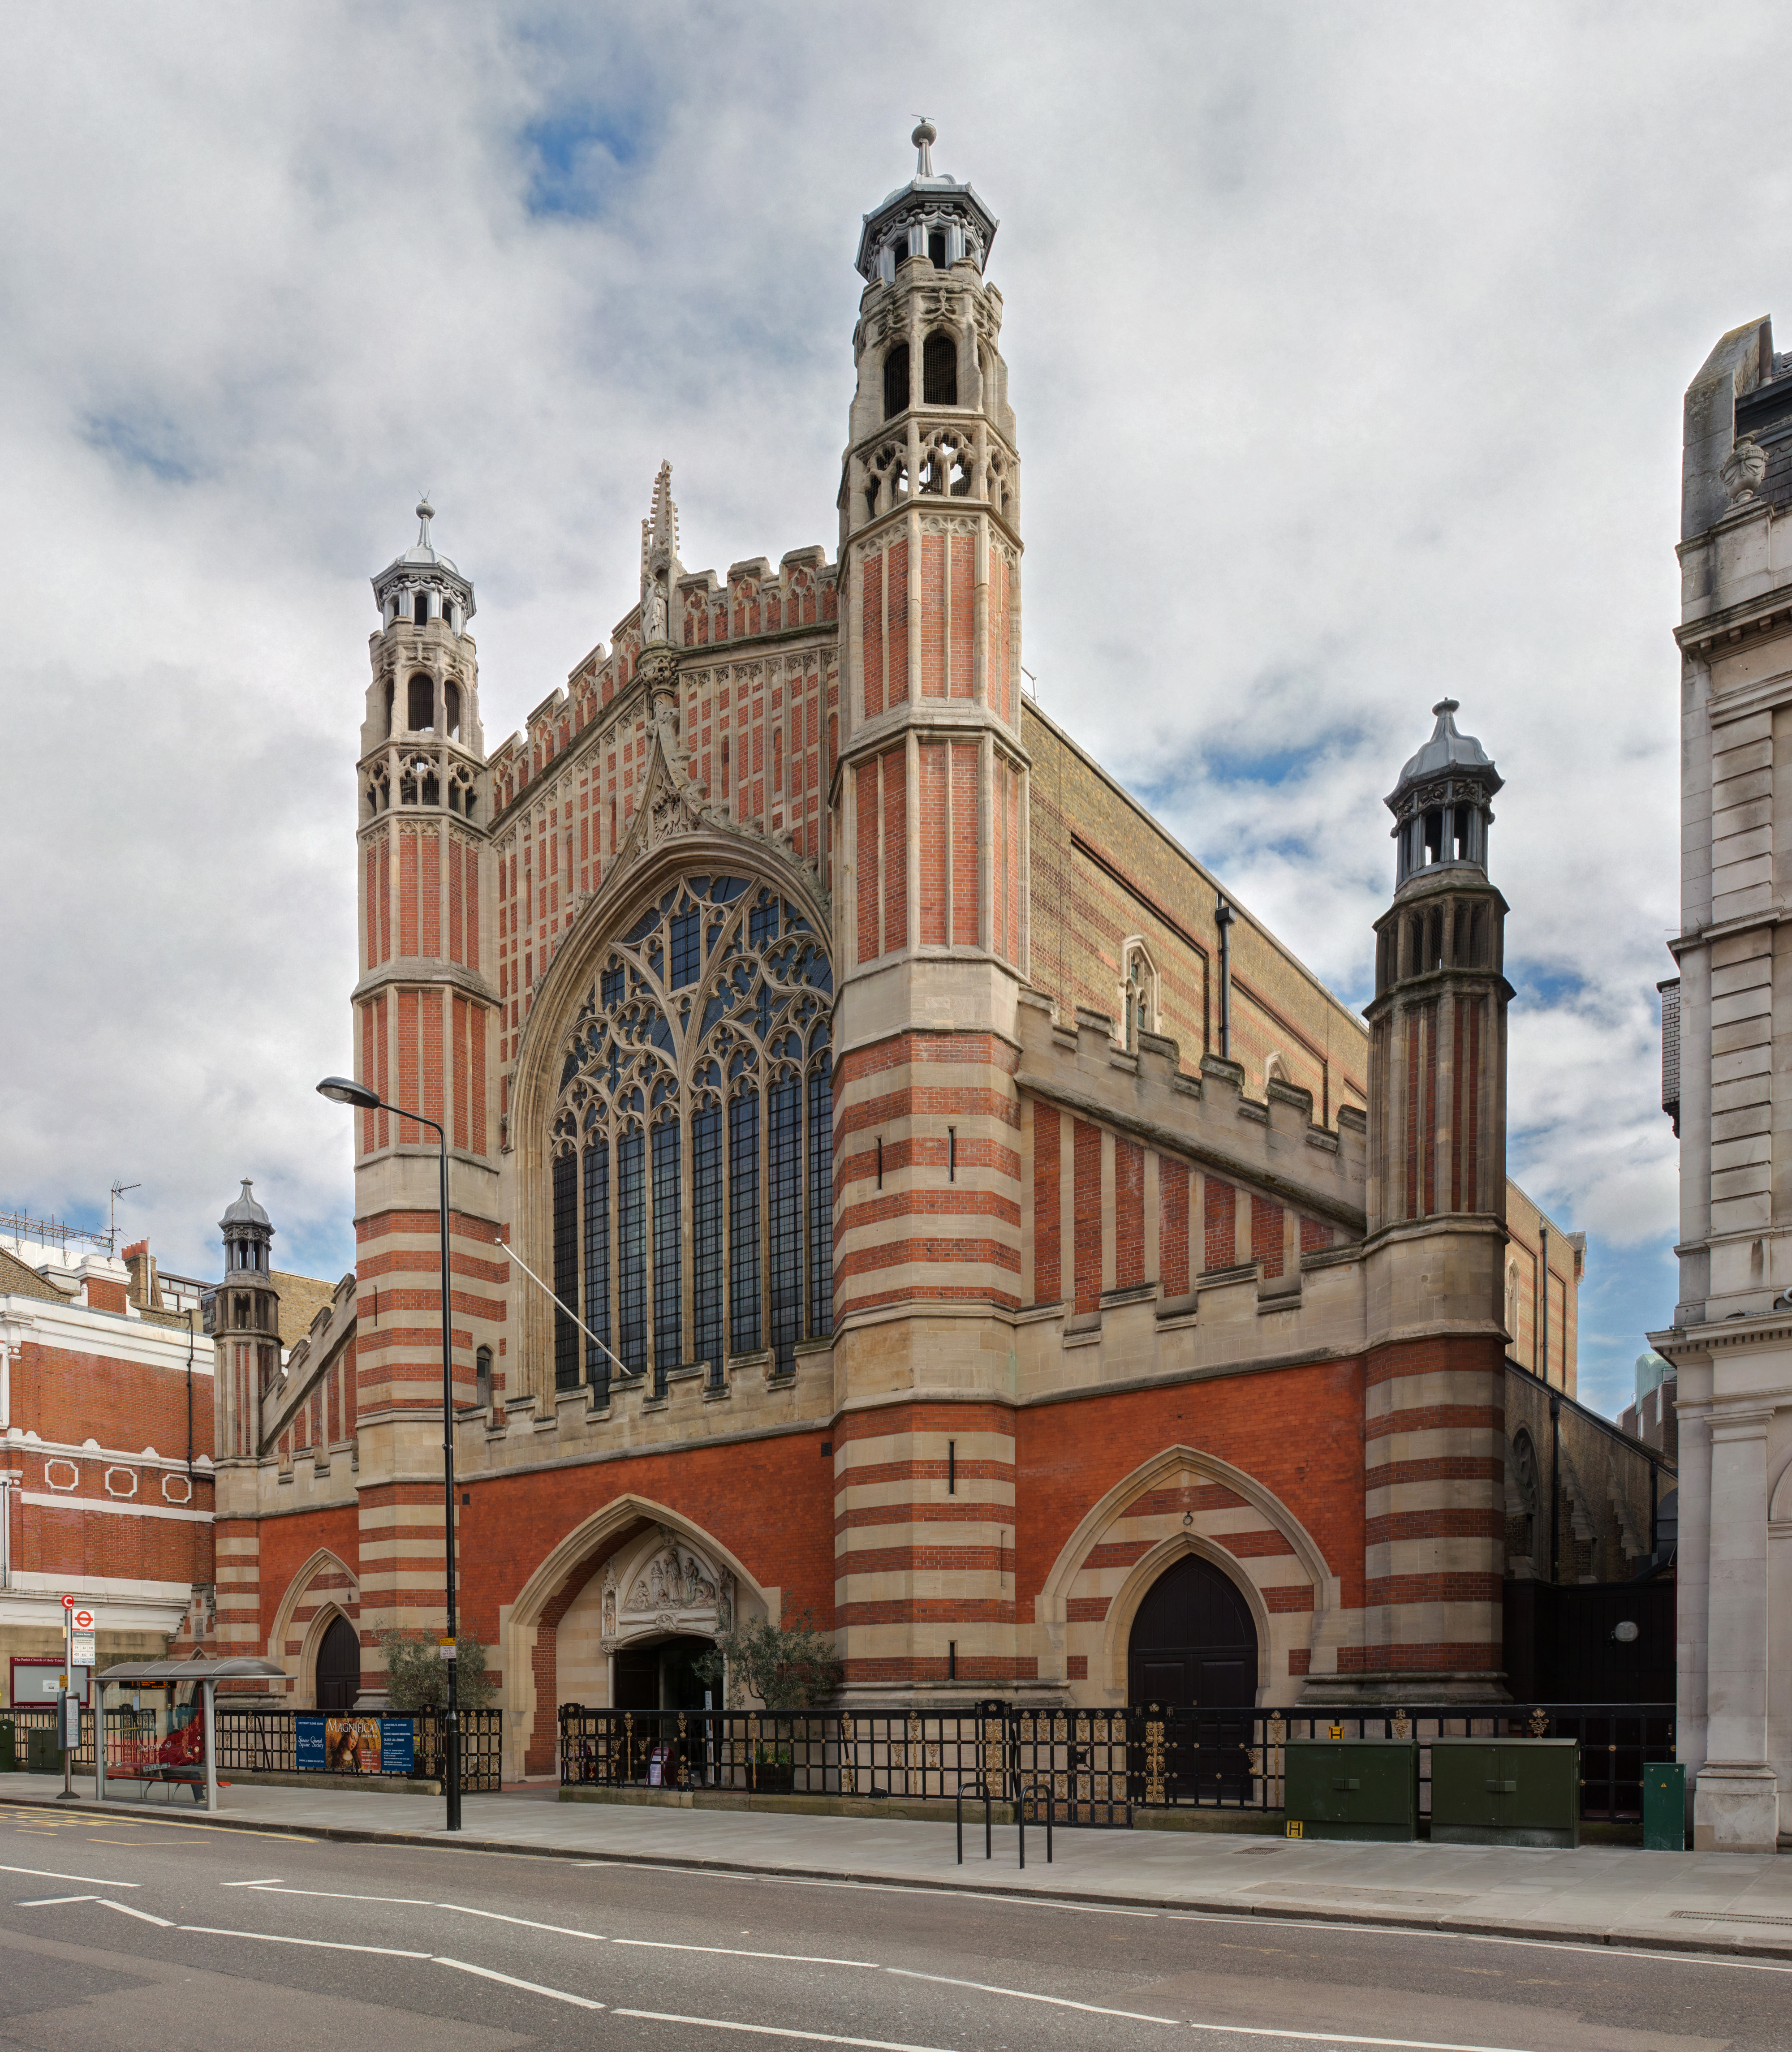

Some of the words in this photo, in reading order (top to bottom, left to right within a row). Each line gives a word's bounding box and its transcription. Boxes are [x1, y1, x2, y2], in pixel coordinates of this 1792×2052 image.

[65, 1596, 72, 1606] C
[327, 1719, 379, 1733] MAGNIFICAT
[1289, 1822, 1300, 1836] H
